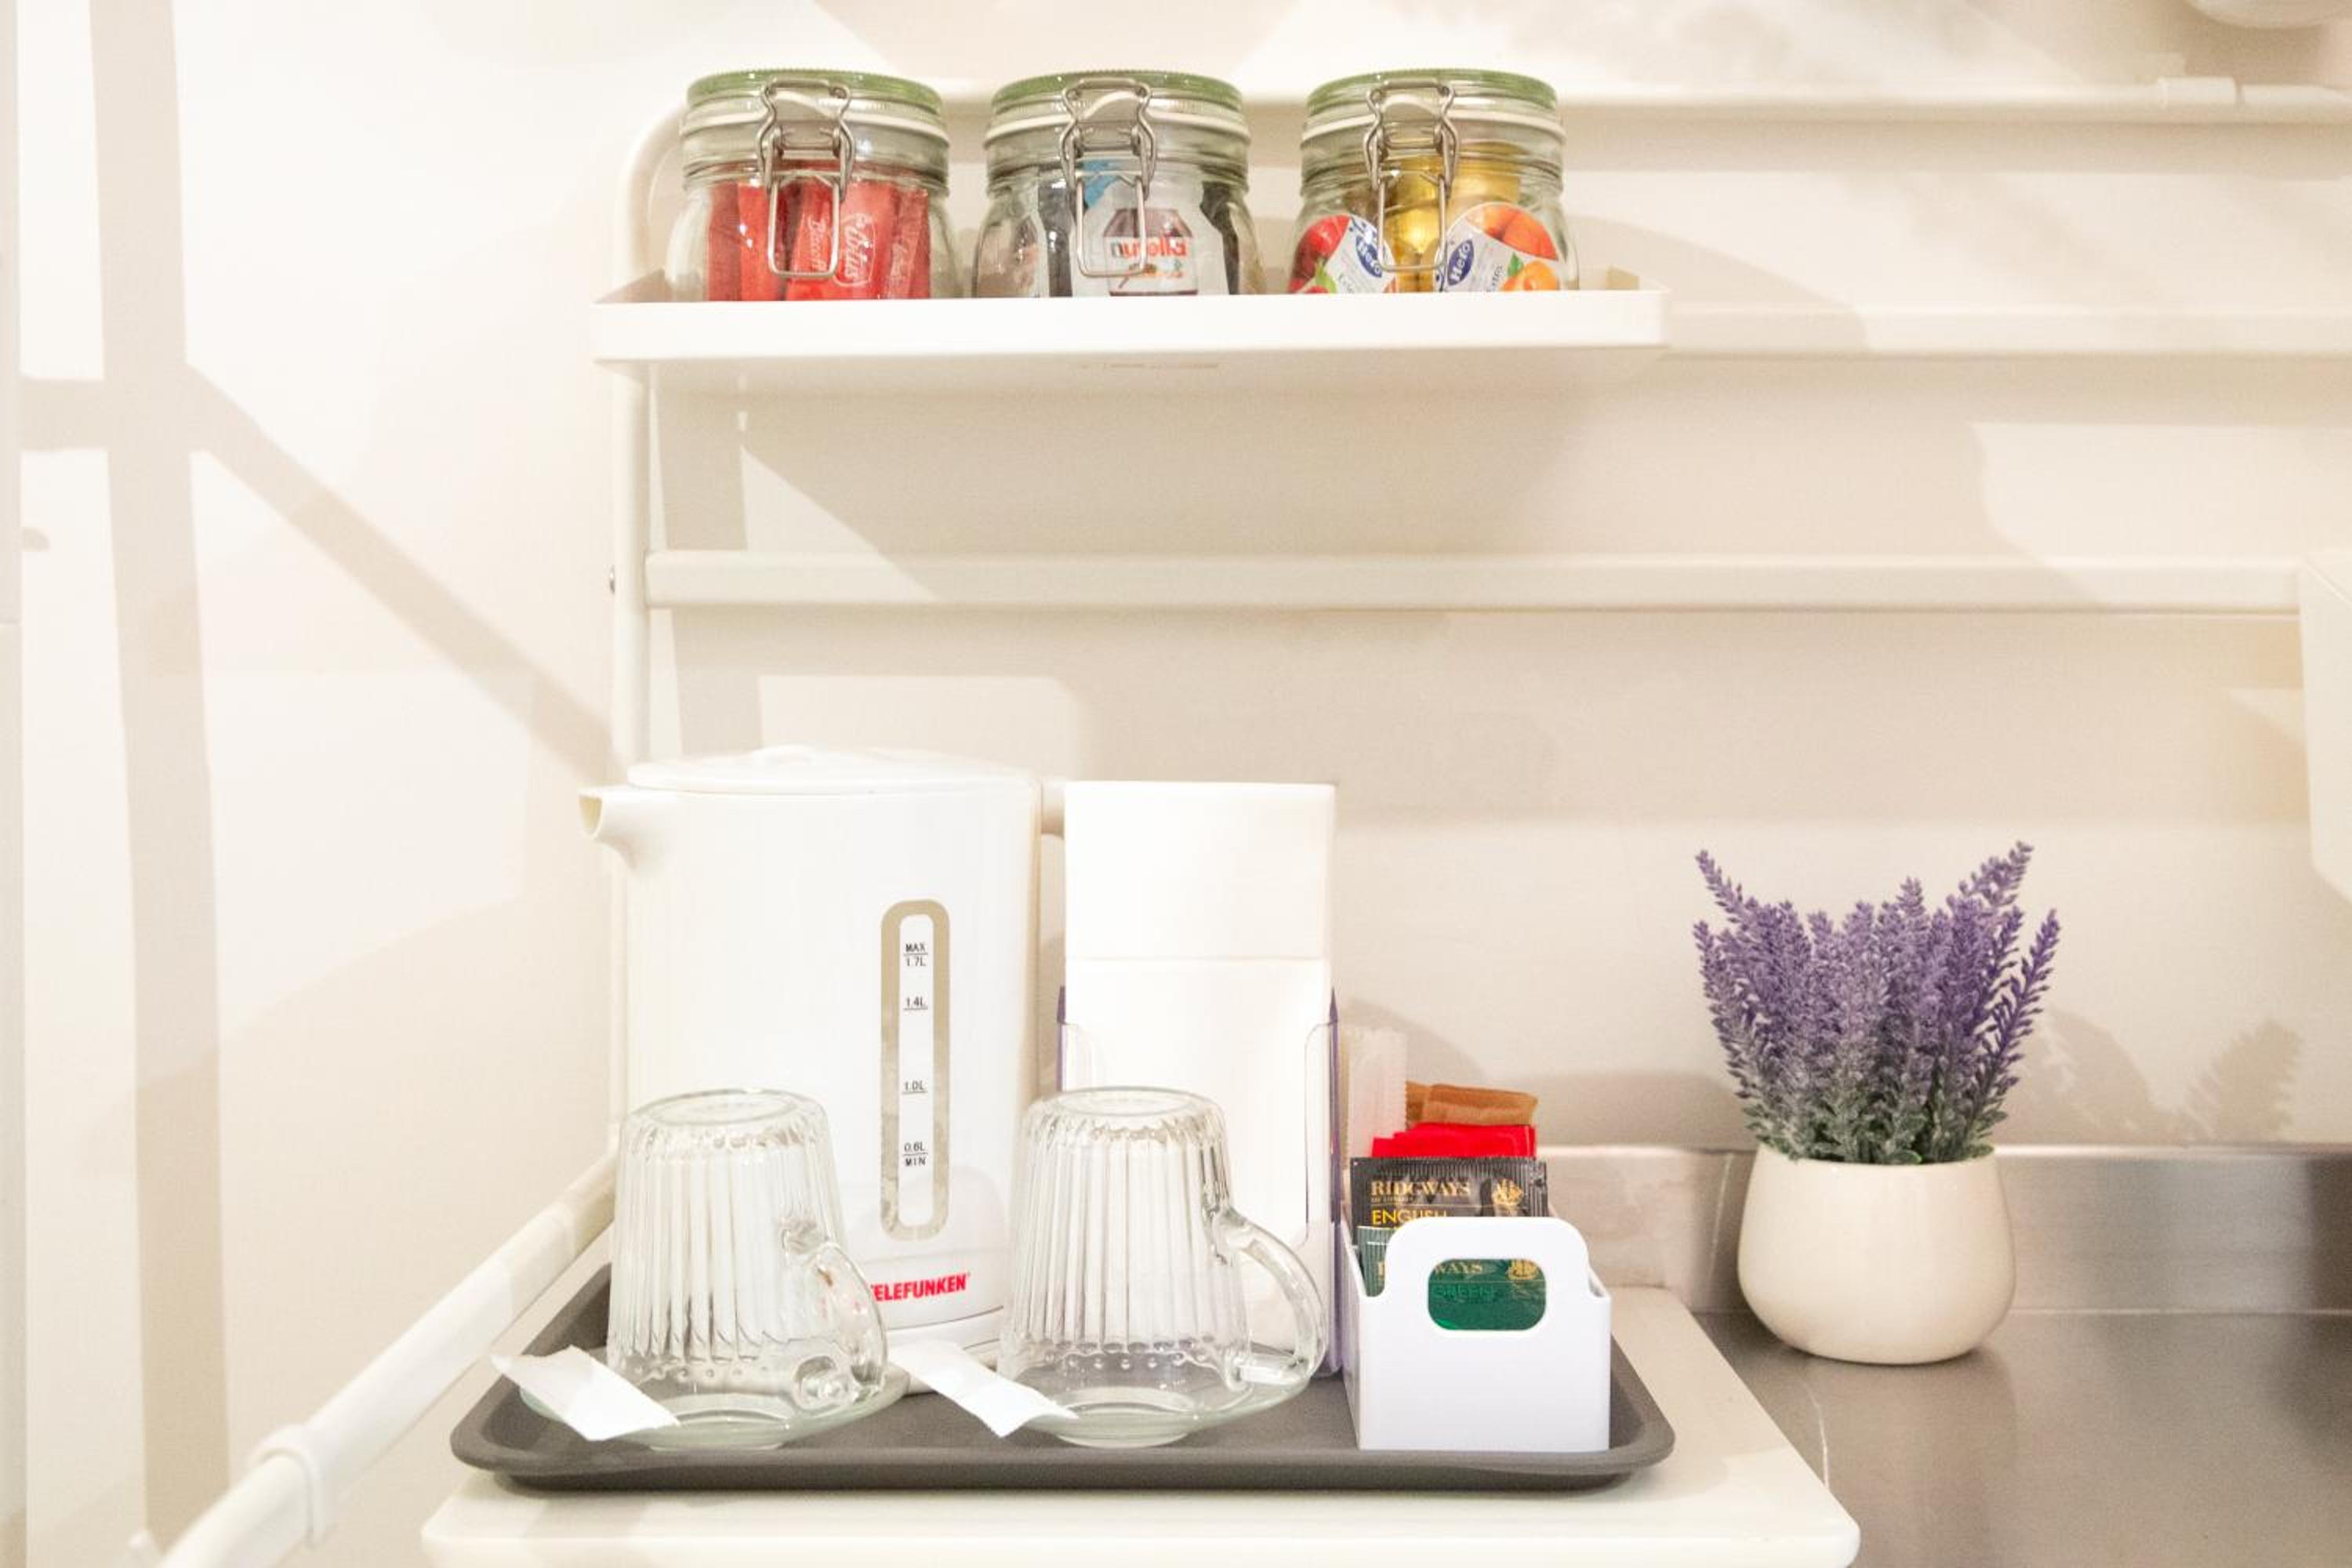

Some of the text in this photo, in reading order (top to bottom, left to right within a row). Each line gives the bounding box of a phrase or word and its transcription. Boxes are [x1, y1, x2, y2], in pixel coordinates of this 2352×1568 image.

[1109, 237, 1187, 258] nuella
[1450, 243, 1471, 281] Hero
[906, 943, 926, 953] MAX
[906, 956, 927, 967] 1.7L
[906, 996, 926, 1007] 1.4L
[905, 1156, 927, 1167] MIN
[871, 1273, 967, 1301] ELEFUNKEN
